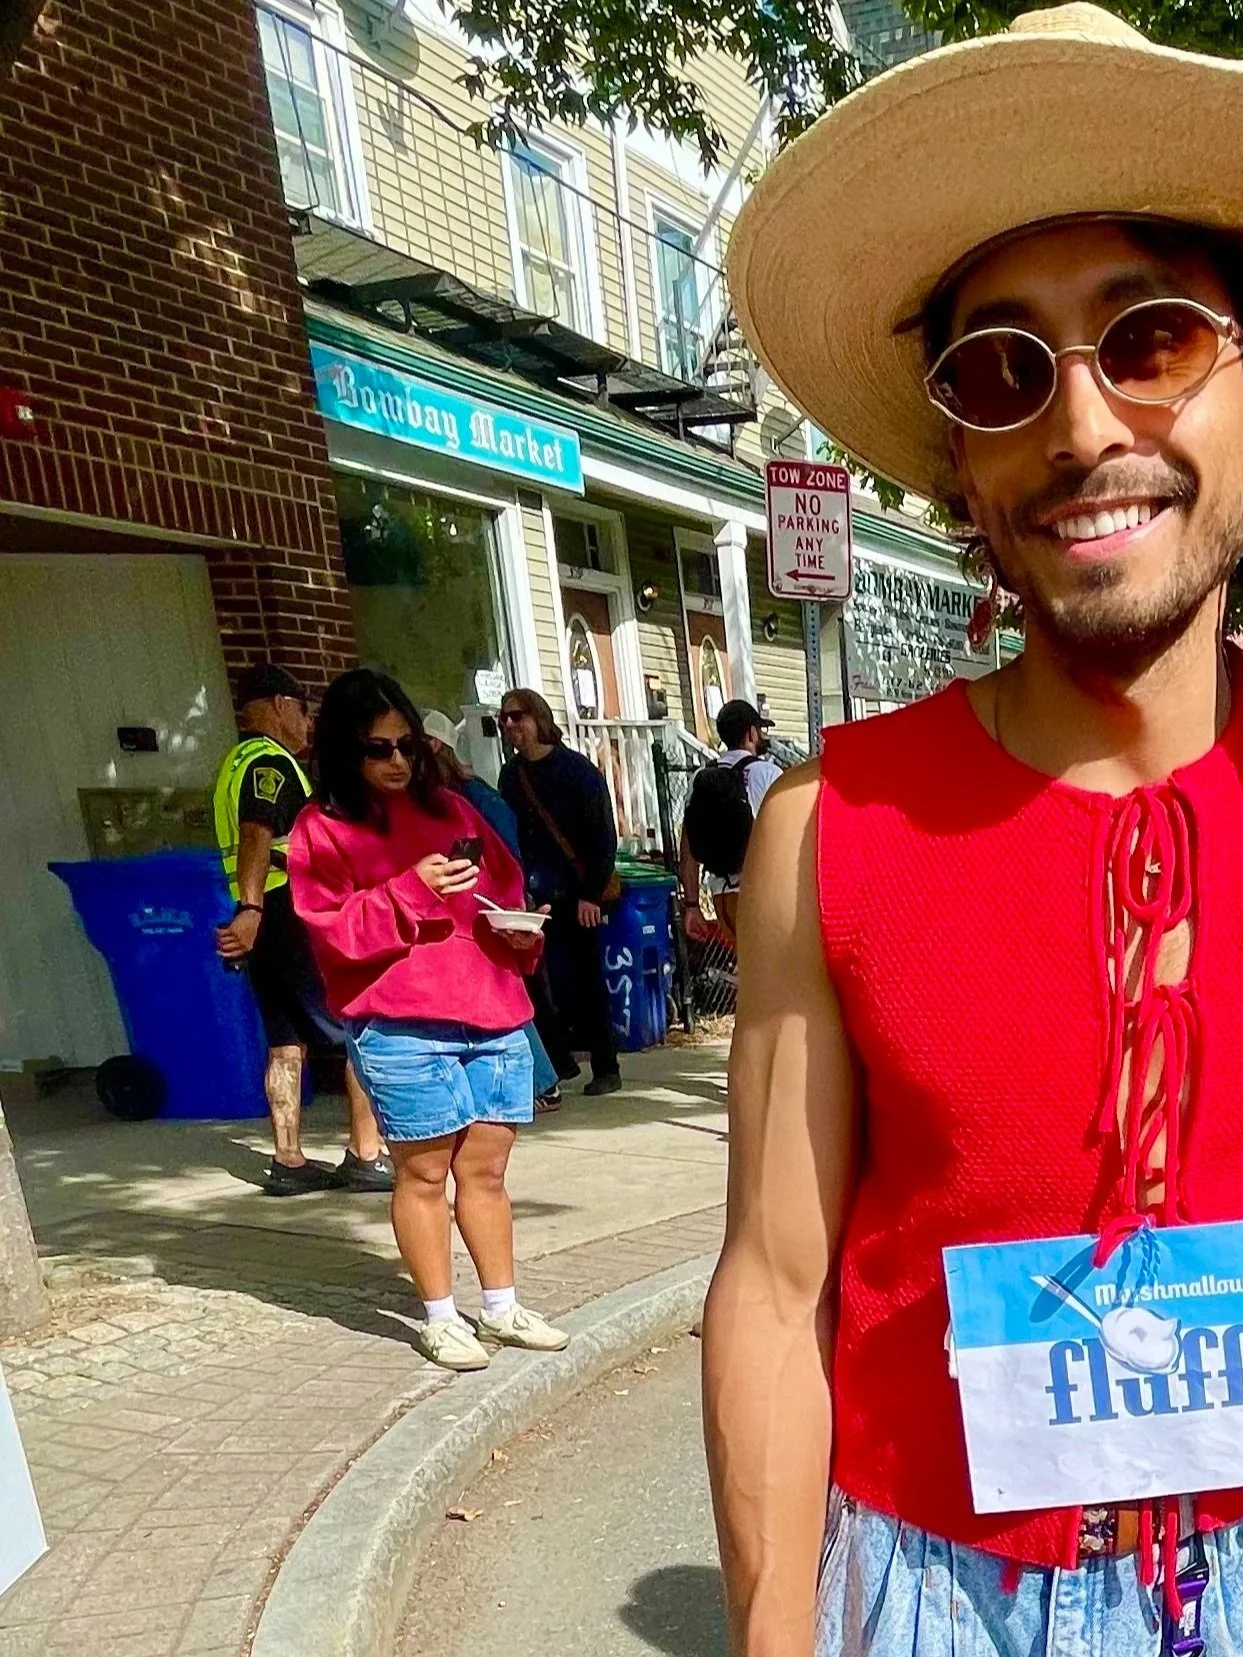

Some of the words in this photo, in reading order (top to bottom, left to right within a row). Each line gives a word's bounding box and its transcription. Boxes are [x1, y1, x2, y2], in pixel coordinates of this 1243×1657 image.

[334, 363, 460, 450] Bombay
[470, 410, 564, 472] Market
[770, 466, 800, 484] TOW
[806, 471, 846, 490] ZONE
[795, 493, 821, 515] NO
[778, 515, 840, 534] PARKING
[796, 537, 823, 551] ANY
[796, 553, 825, 569] TIME
[927, 583, 980, 618] MARK
